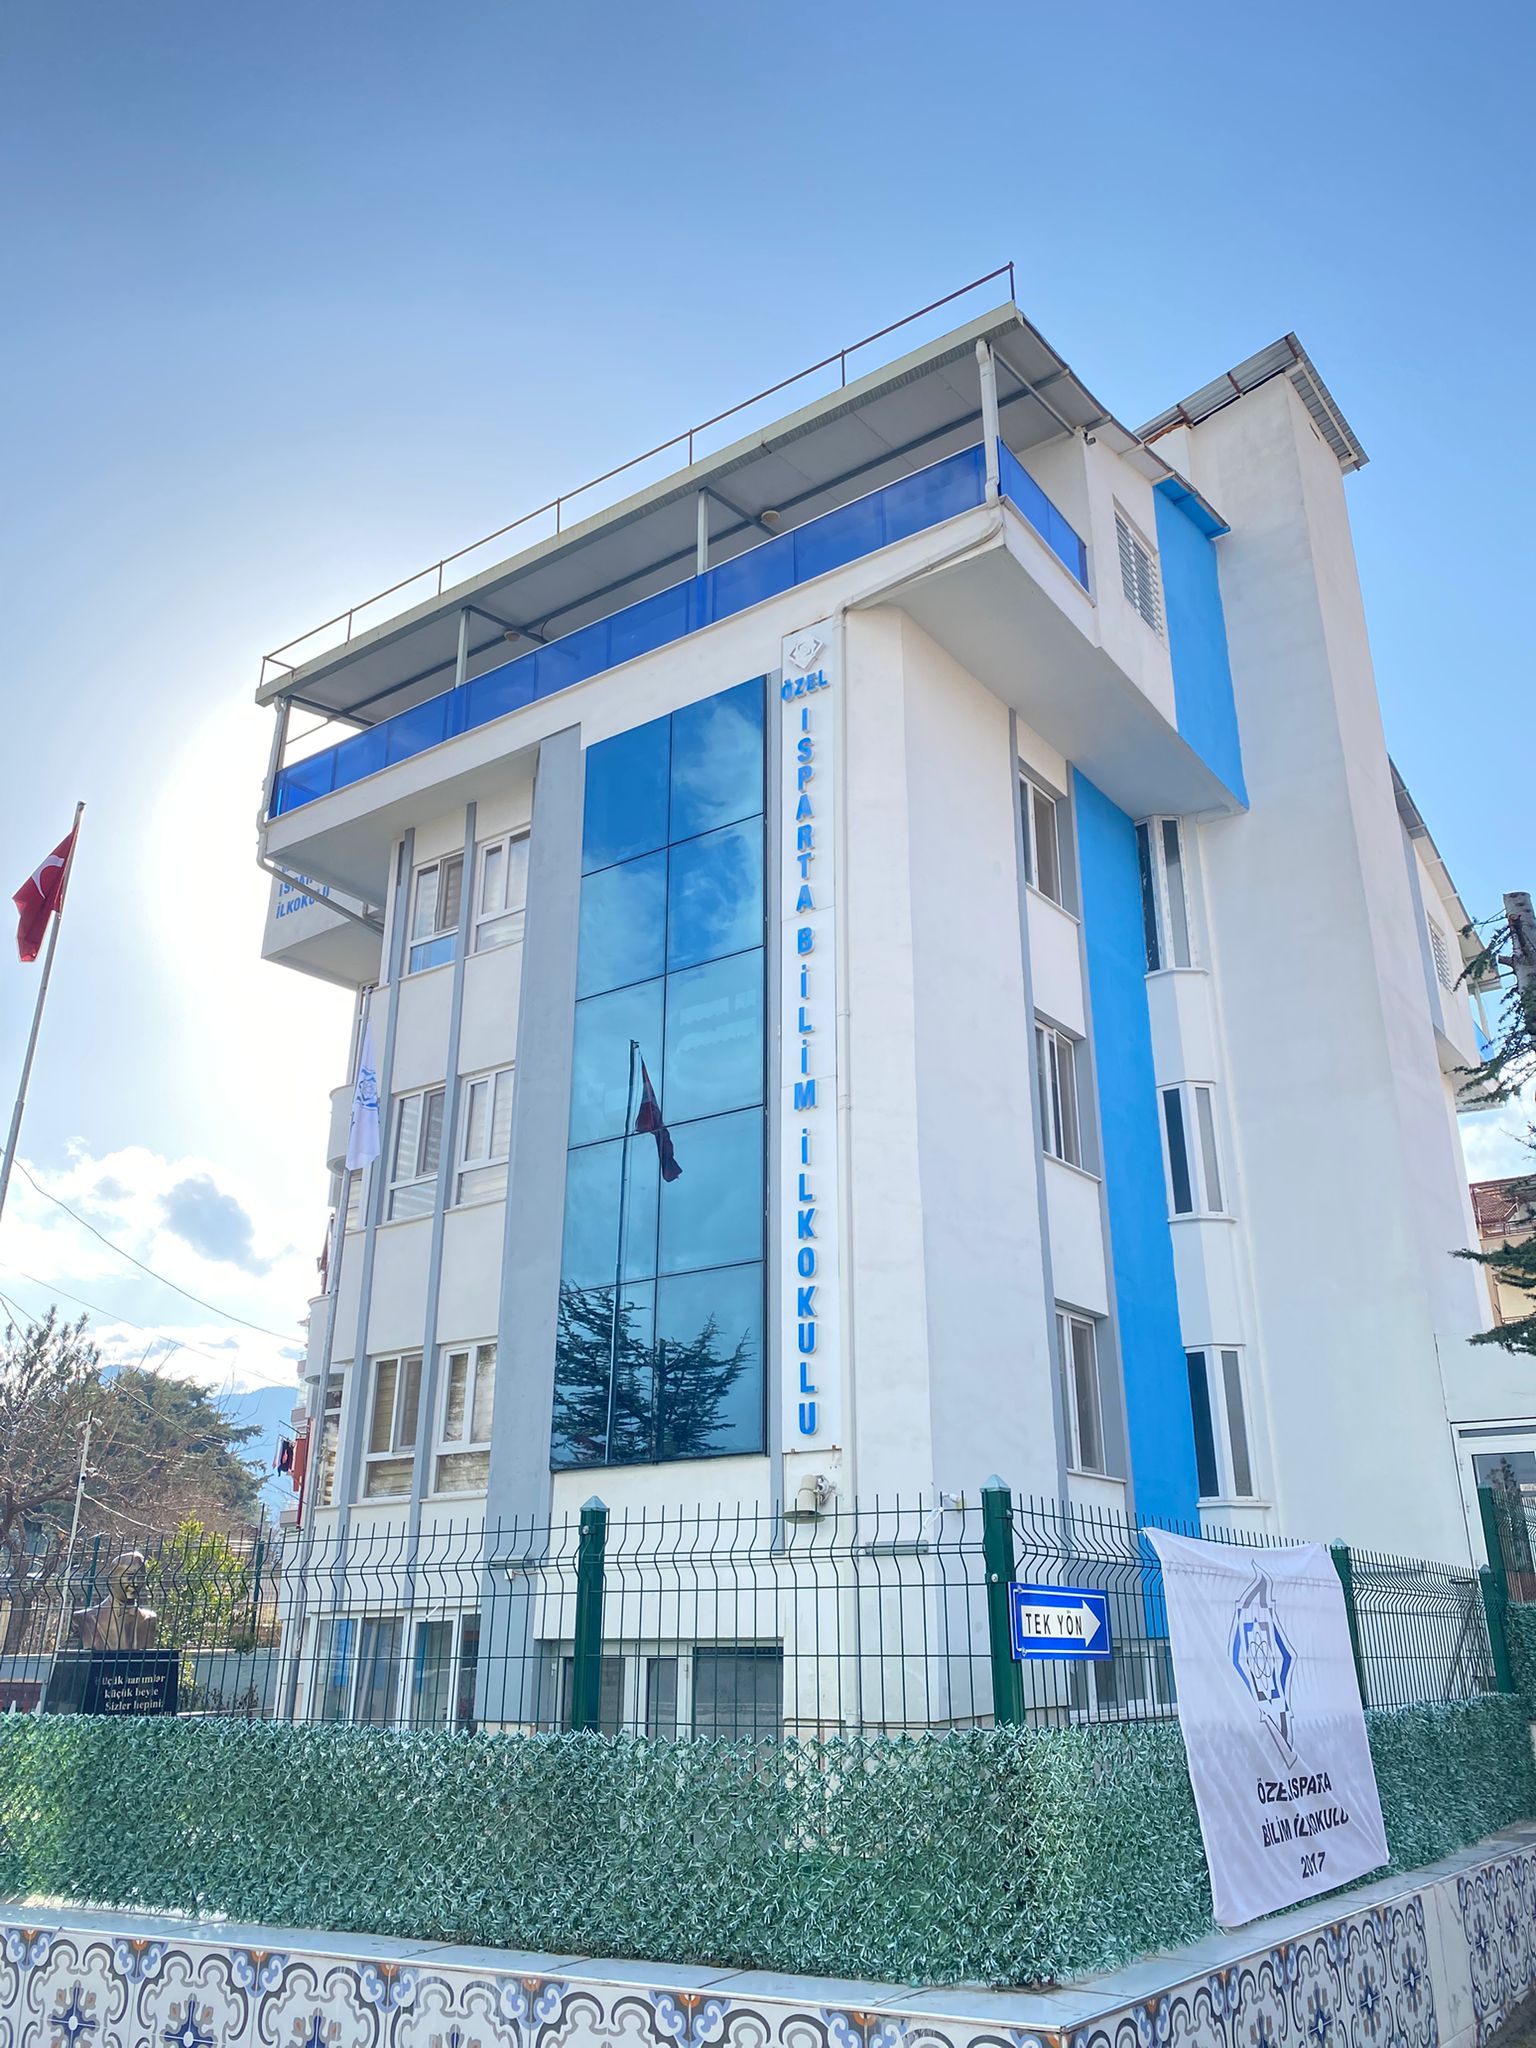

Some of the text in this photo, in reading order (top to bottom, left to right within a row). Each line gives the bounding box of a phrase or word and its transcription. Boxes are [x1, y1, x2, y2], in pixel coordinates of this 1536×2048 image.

[781, 669, 829, 702] ÖZEL
[794, 707, 818, 1436] ISPARTA BİLİM İLKOKULU
[1025, 1610, 1083, 1636] TEK YÖN
[133, 1698, 163, 1711] hepini
[1261, 1815, 1293, 1848] BİLİM
[1301, 1851, 1326, 1879] 2017
